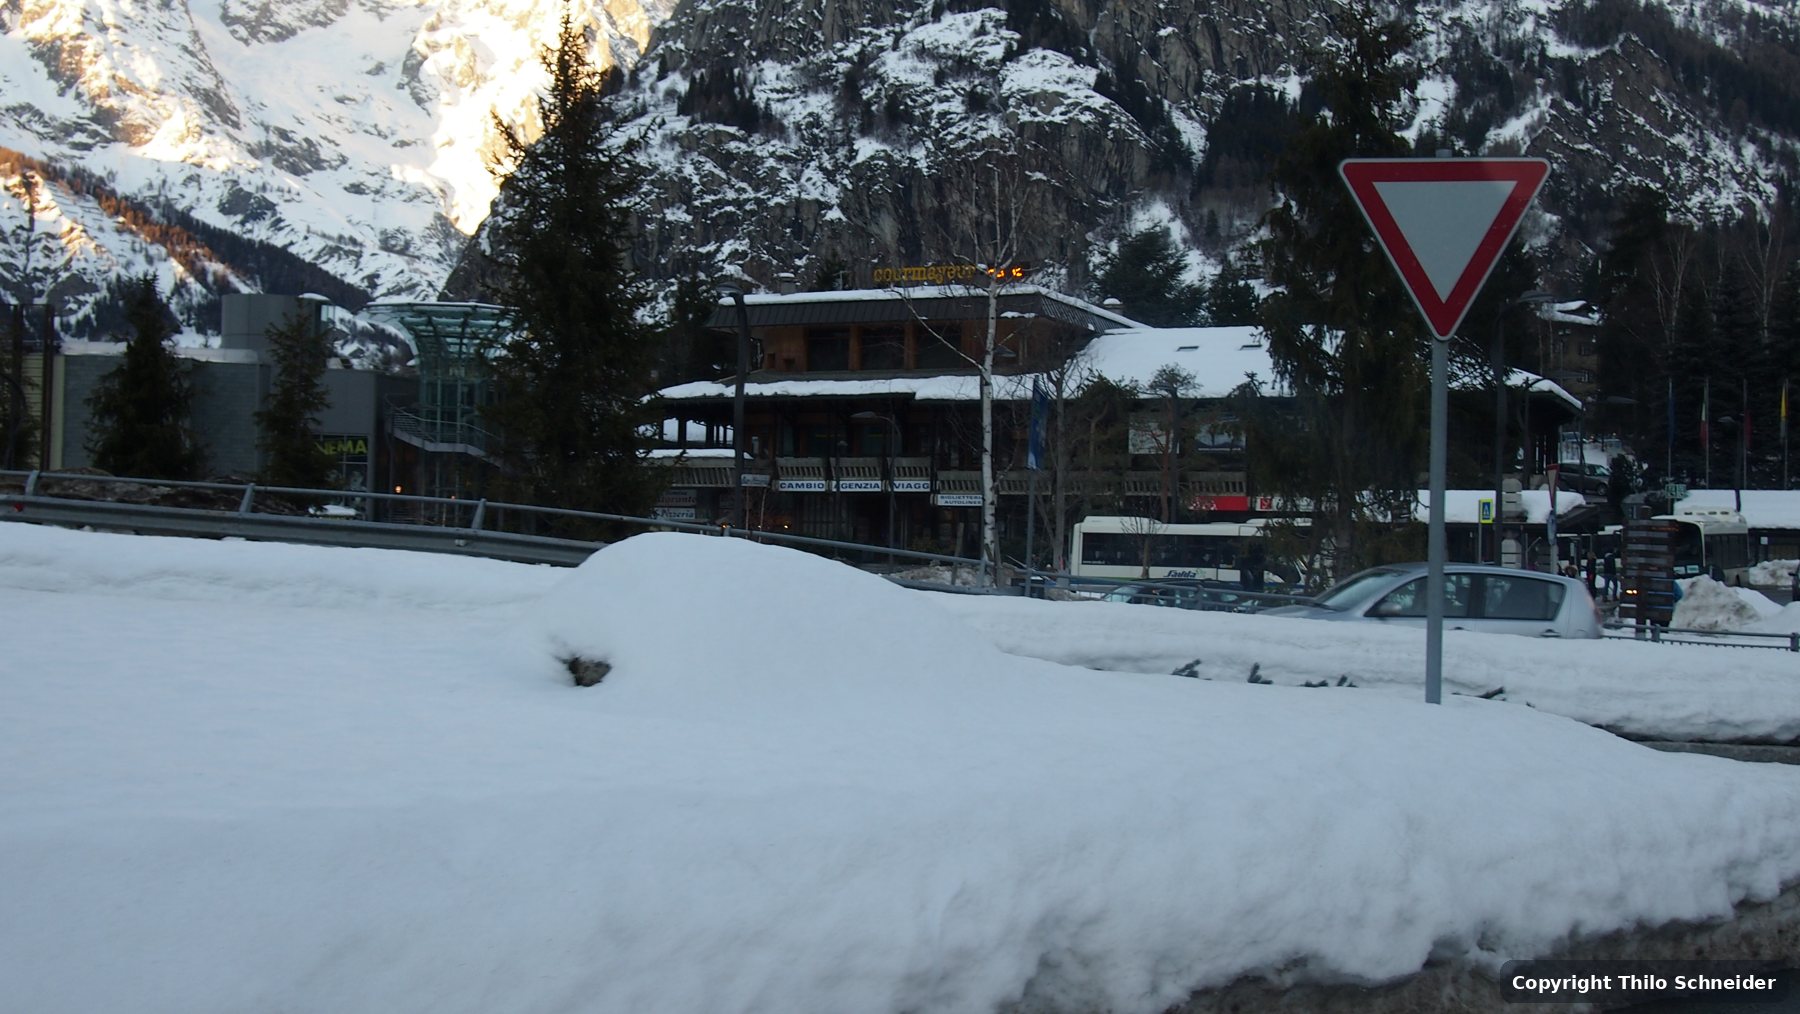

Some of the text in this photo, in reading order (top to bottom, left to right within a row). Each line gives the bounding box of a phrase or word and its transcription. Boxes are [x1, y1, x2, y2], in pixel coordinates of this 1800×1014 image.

[314, 439, 368, 455] NEMA
[780, 482, 825, 490] CAMBIO
[893, 482, 930, 490] VIAGG
